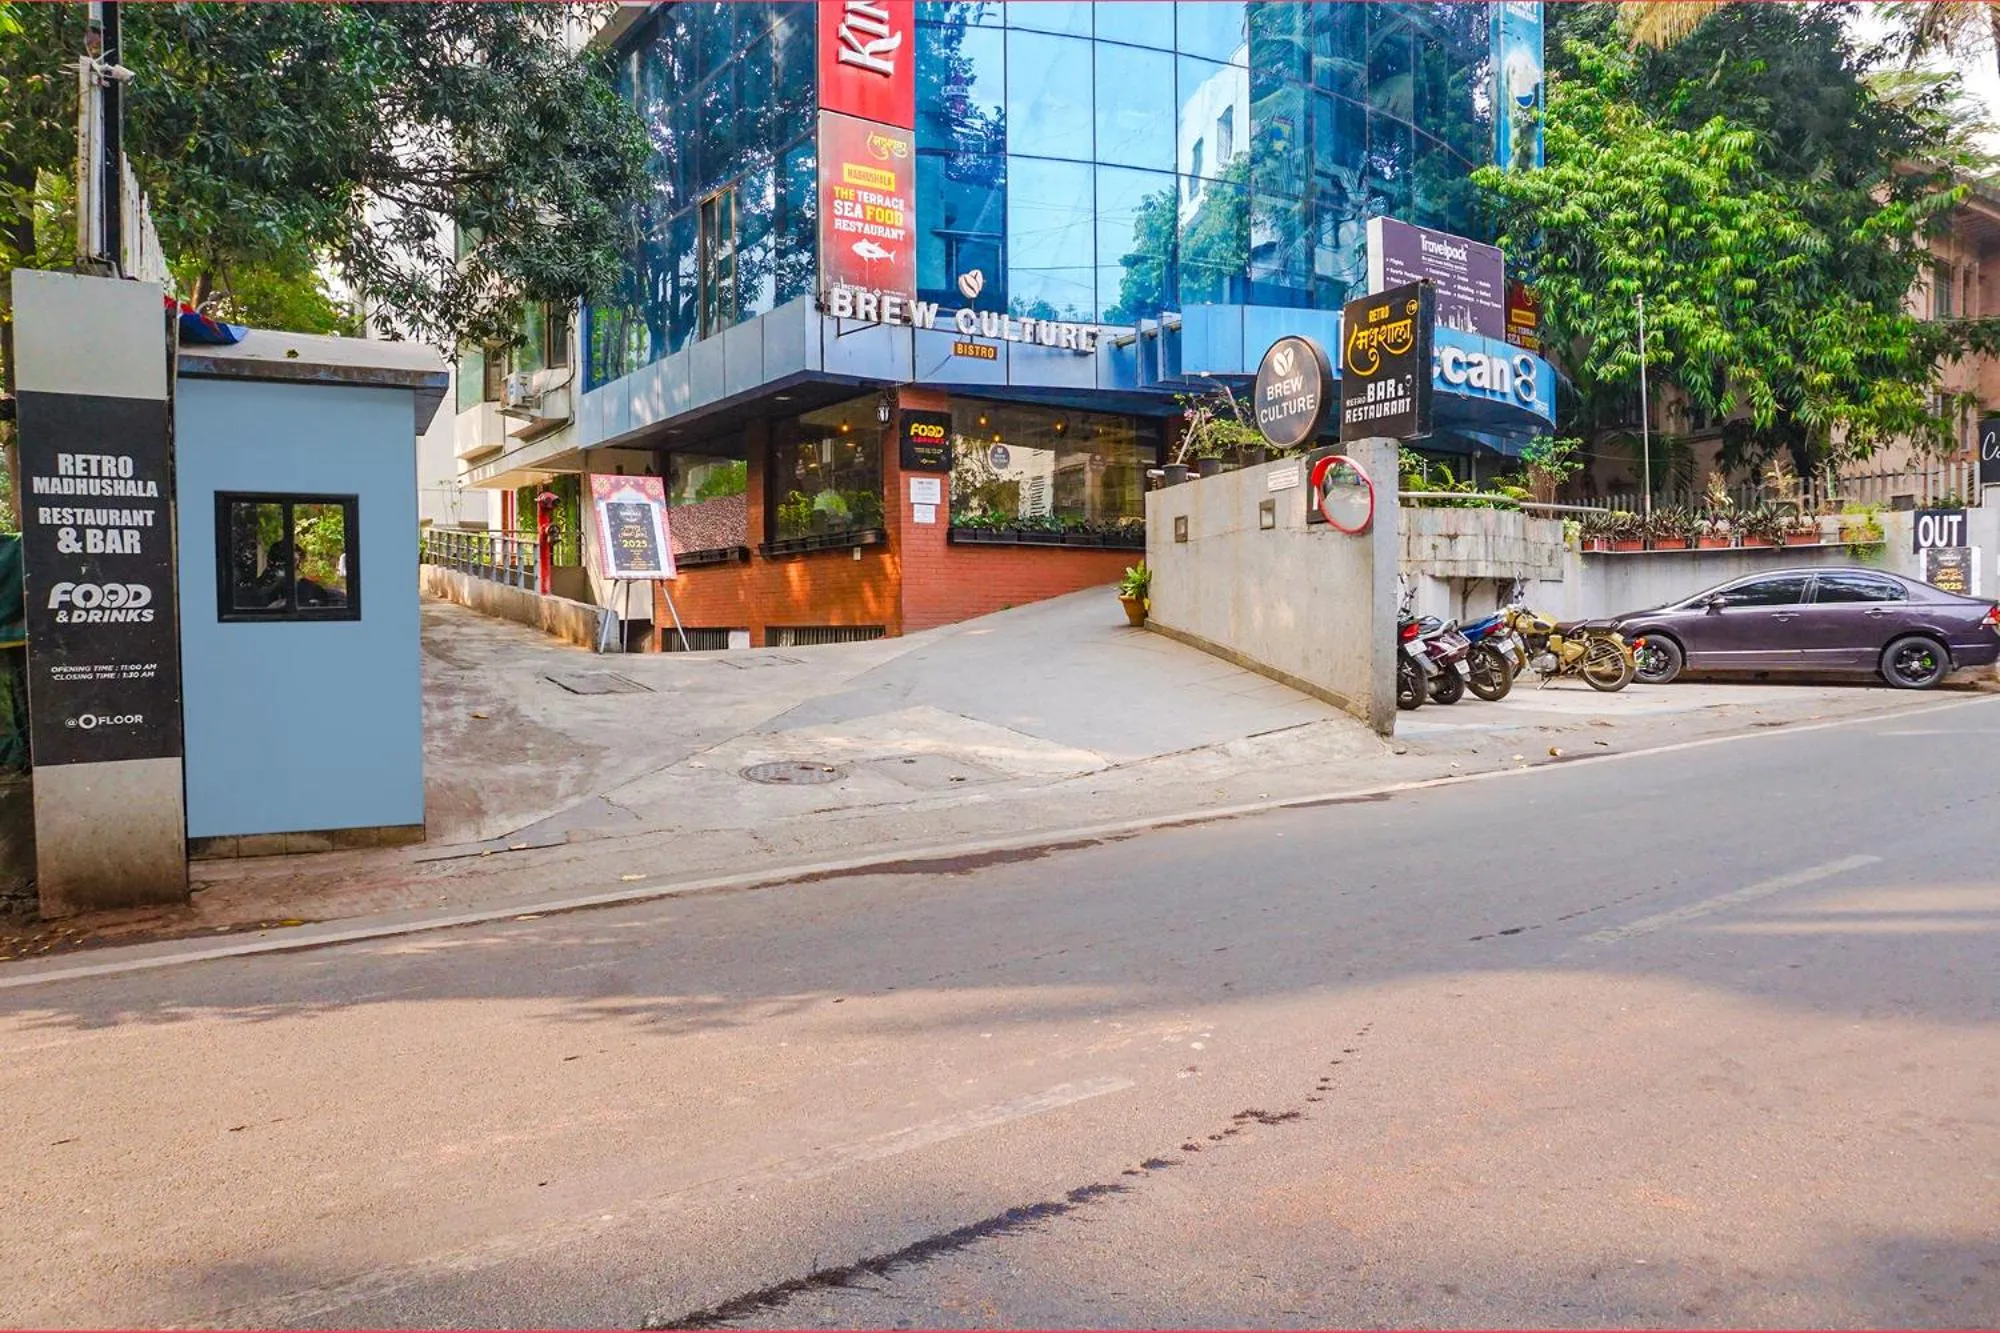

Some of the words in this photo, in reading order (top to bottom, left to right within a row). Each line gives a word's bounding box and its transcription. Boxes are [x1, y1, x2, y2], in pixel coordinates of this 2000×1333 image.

[833, 186, 856, 200] THE
[856, 190, 905, 212] TERRACE
[833, 200, 864, 219] SEA
[866, 204, 904, 226] FOOD
[834, 218, 906, 240] RESTAURANT
[1420, 234, 1468, 261] Travelpack
[829, 286, 938, 329] BREW
[955, 308, 1099, 352] CULTURE
[1368, 305, 1390, 323] RETRO
[957, 344, 995, 359] BISTRO
[1266, 375, 1304, 401] BREW
[1367, 378, 1396, 402] BAR
[1397, 383, 1404, 397] &
[1260, 394, 1316, 424] CULTURE
[1345, 398, 1411, 424] RESTAURANT
[910, 423, 944, 438] FOOD
[57, 453, 134, 478] RETRO
[32, 476, 158, 497] MADHUSHALA
[38, 507, 155, 526] RESTAURANT
[57, 527, 83, 554] &
[85, 528, 142, 554] BAR
[1918, 515, 1962, 548] OUT
[48, 582, 152, 609] FOOD
[56, 610, 69, 623] &
[71, 609, 154, 623] DRINKS
[51, 665, 91, 673] OPENING
[98, 714, 143, 725] FLOOR
